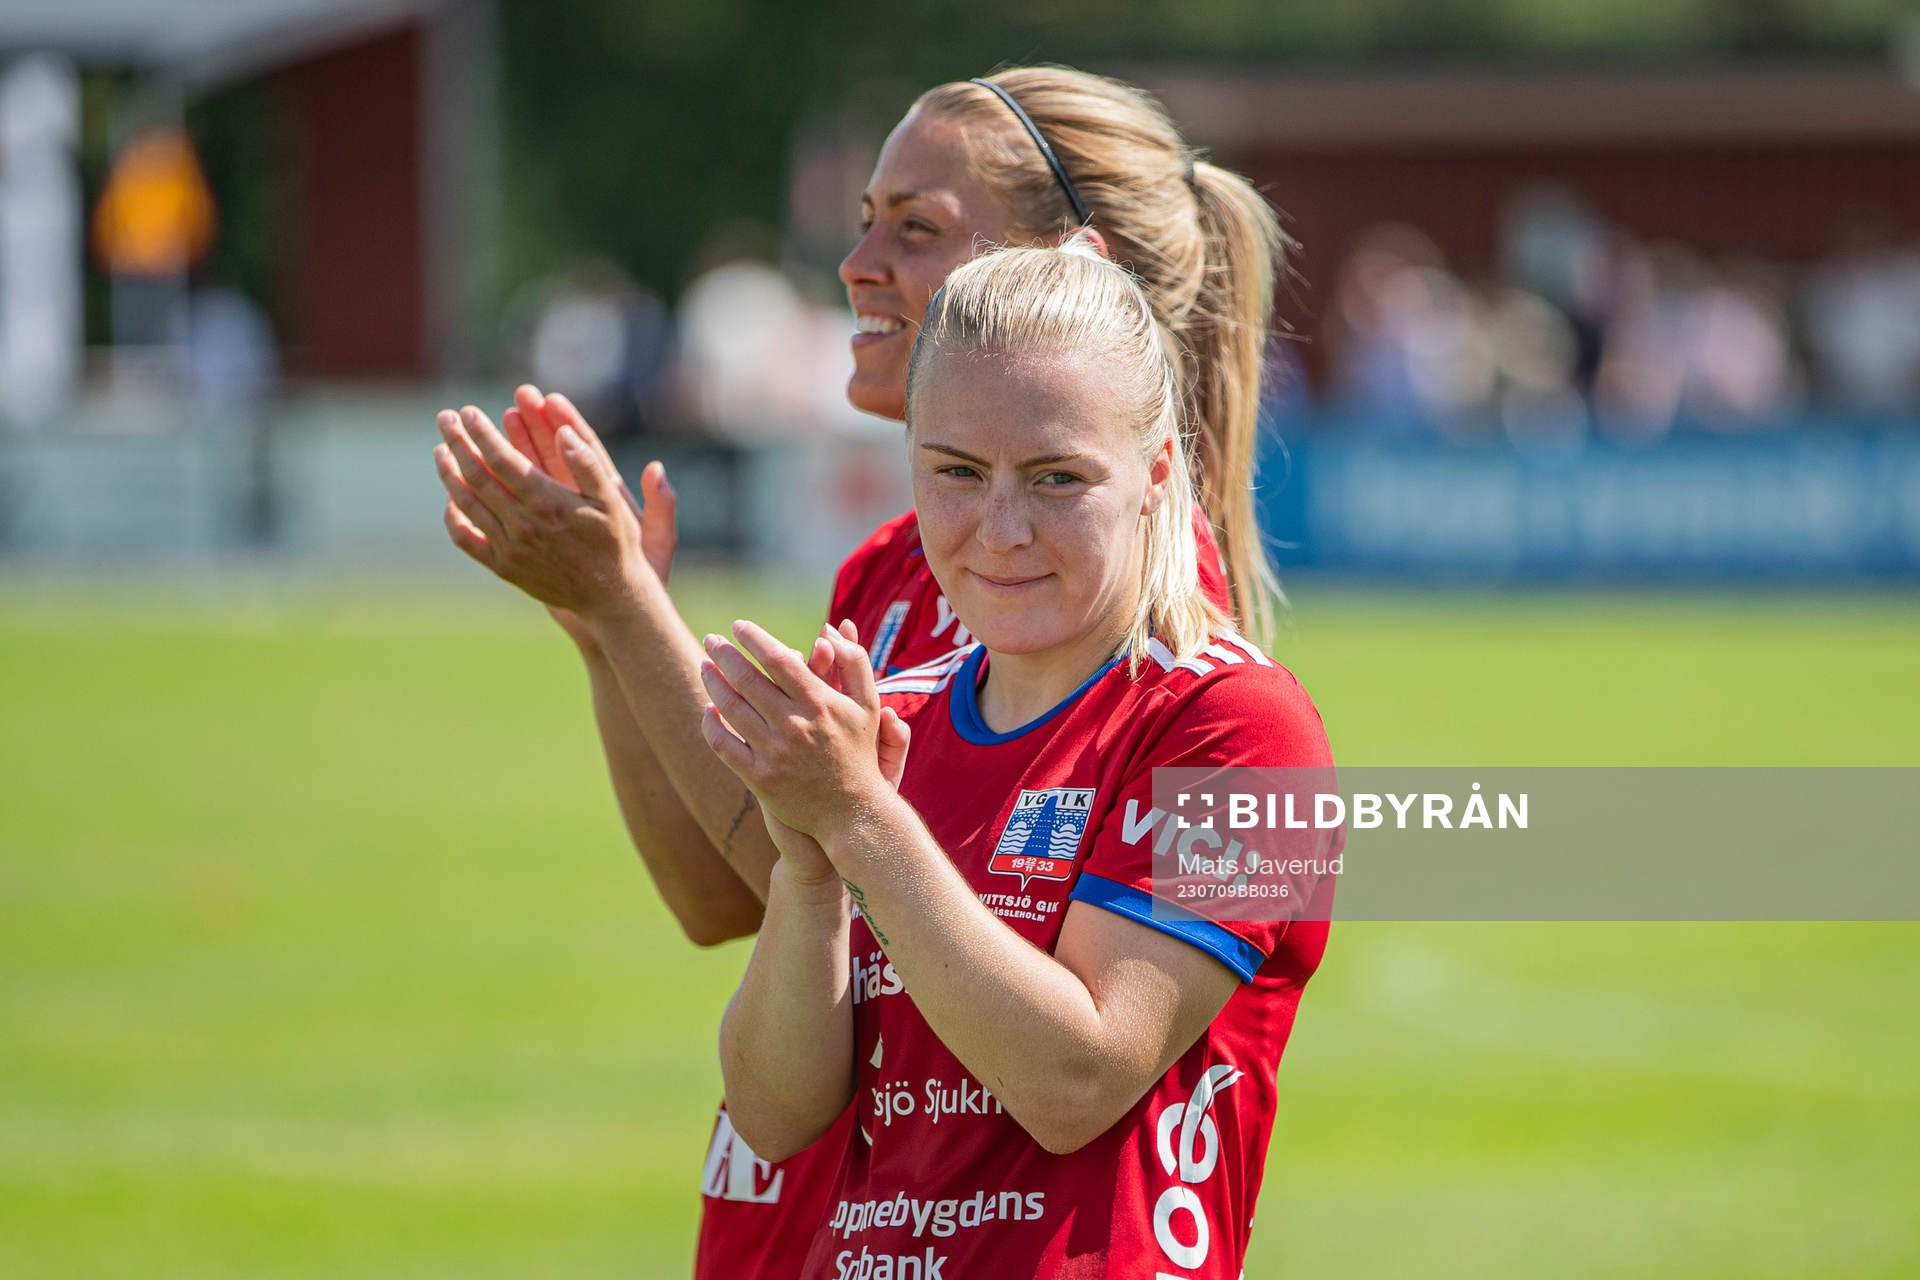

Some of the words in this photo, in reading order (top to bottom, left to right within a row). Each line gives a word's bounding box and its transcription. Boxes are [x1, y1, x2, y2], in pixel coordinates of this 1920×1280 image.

[979, 893, 1031, 909] VITTSJÖ
[1036, 900, 1059, 913] GIK
[853, 950, 904, 1005] häs
[872, 1081, 915, 1127] sjö
